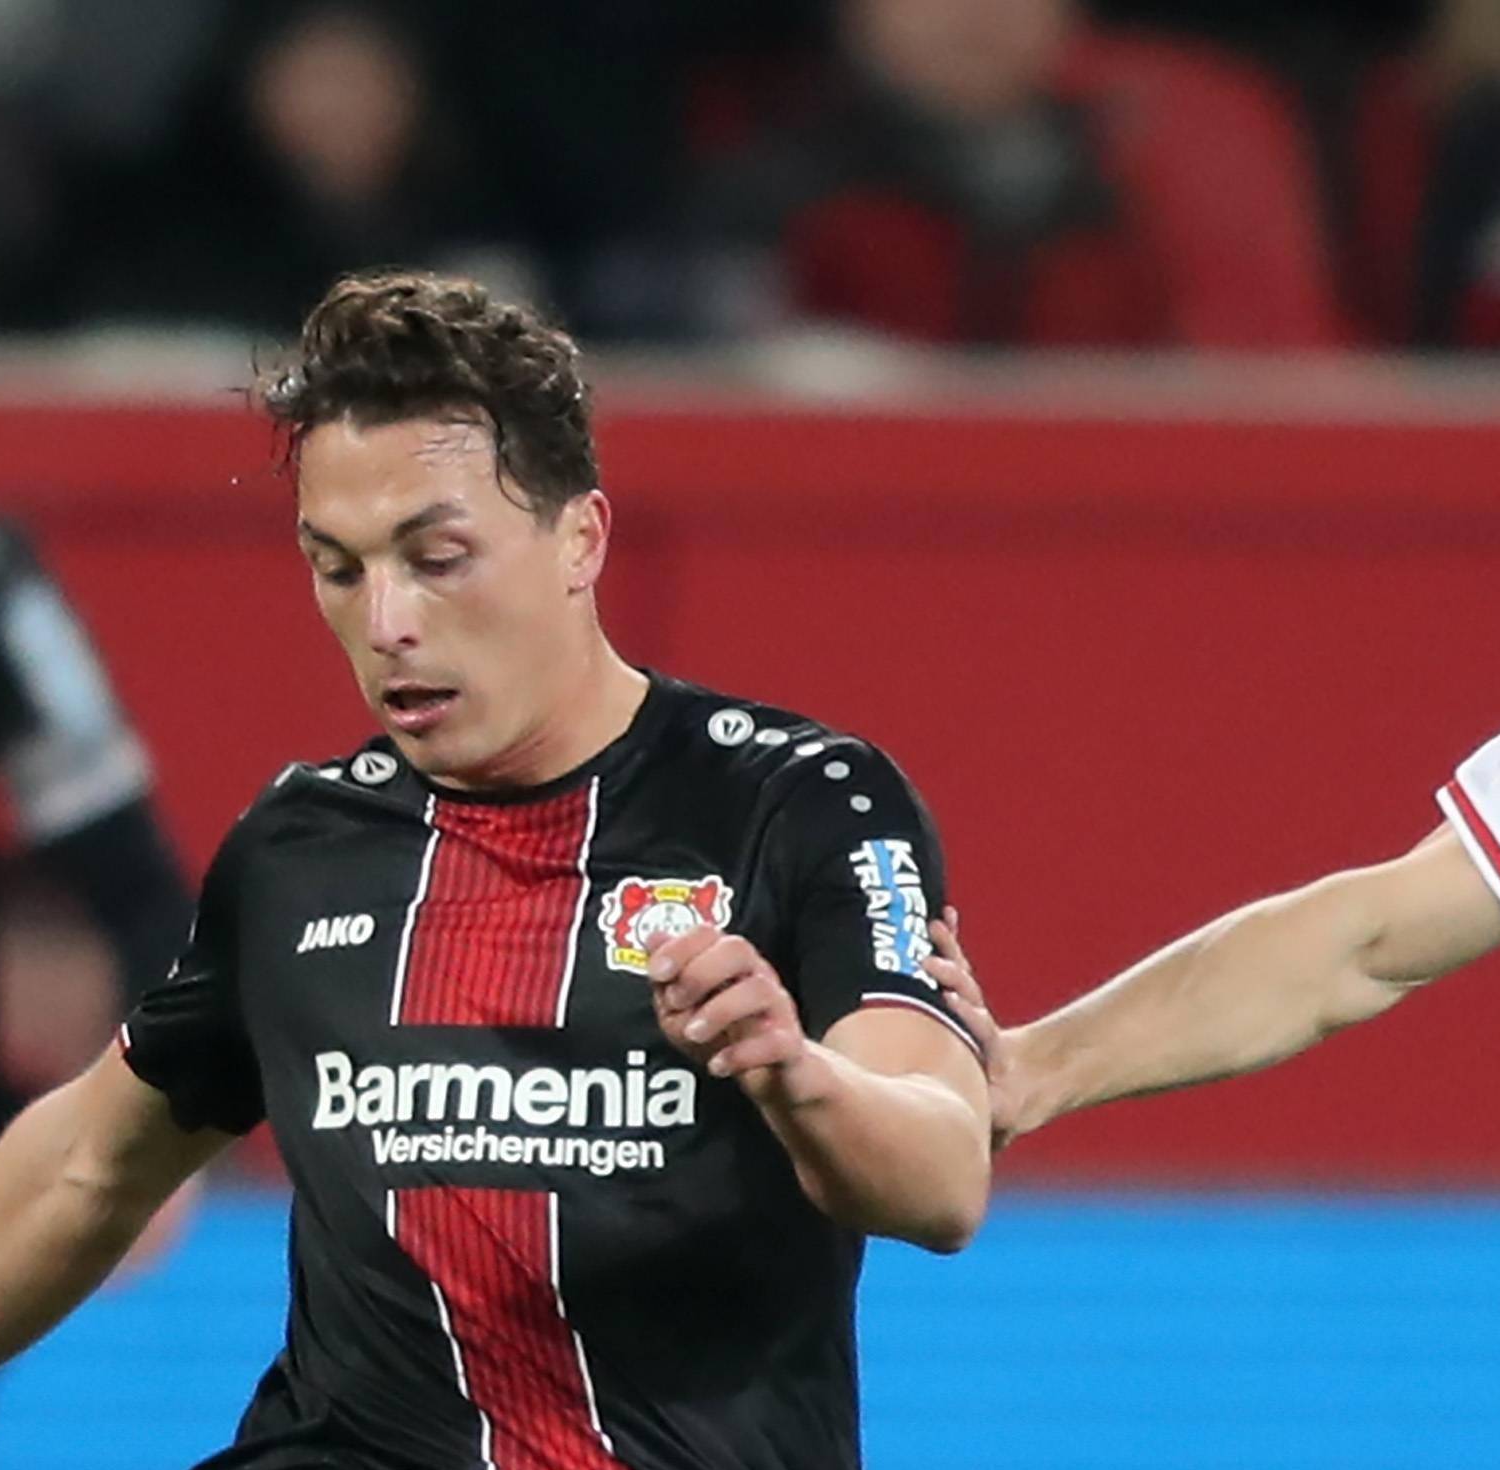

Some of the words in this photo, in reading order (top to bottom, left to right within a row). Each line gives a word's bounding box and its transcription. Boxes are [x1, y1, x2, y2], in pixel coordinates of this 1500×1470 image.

[297, 914, 376, 954] JAKO
[312, 1049, 698, 1130] Barmenia
[372, 1126, 665, 1177] Versicherungen
